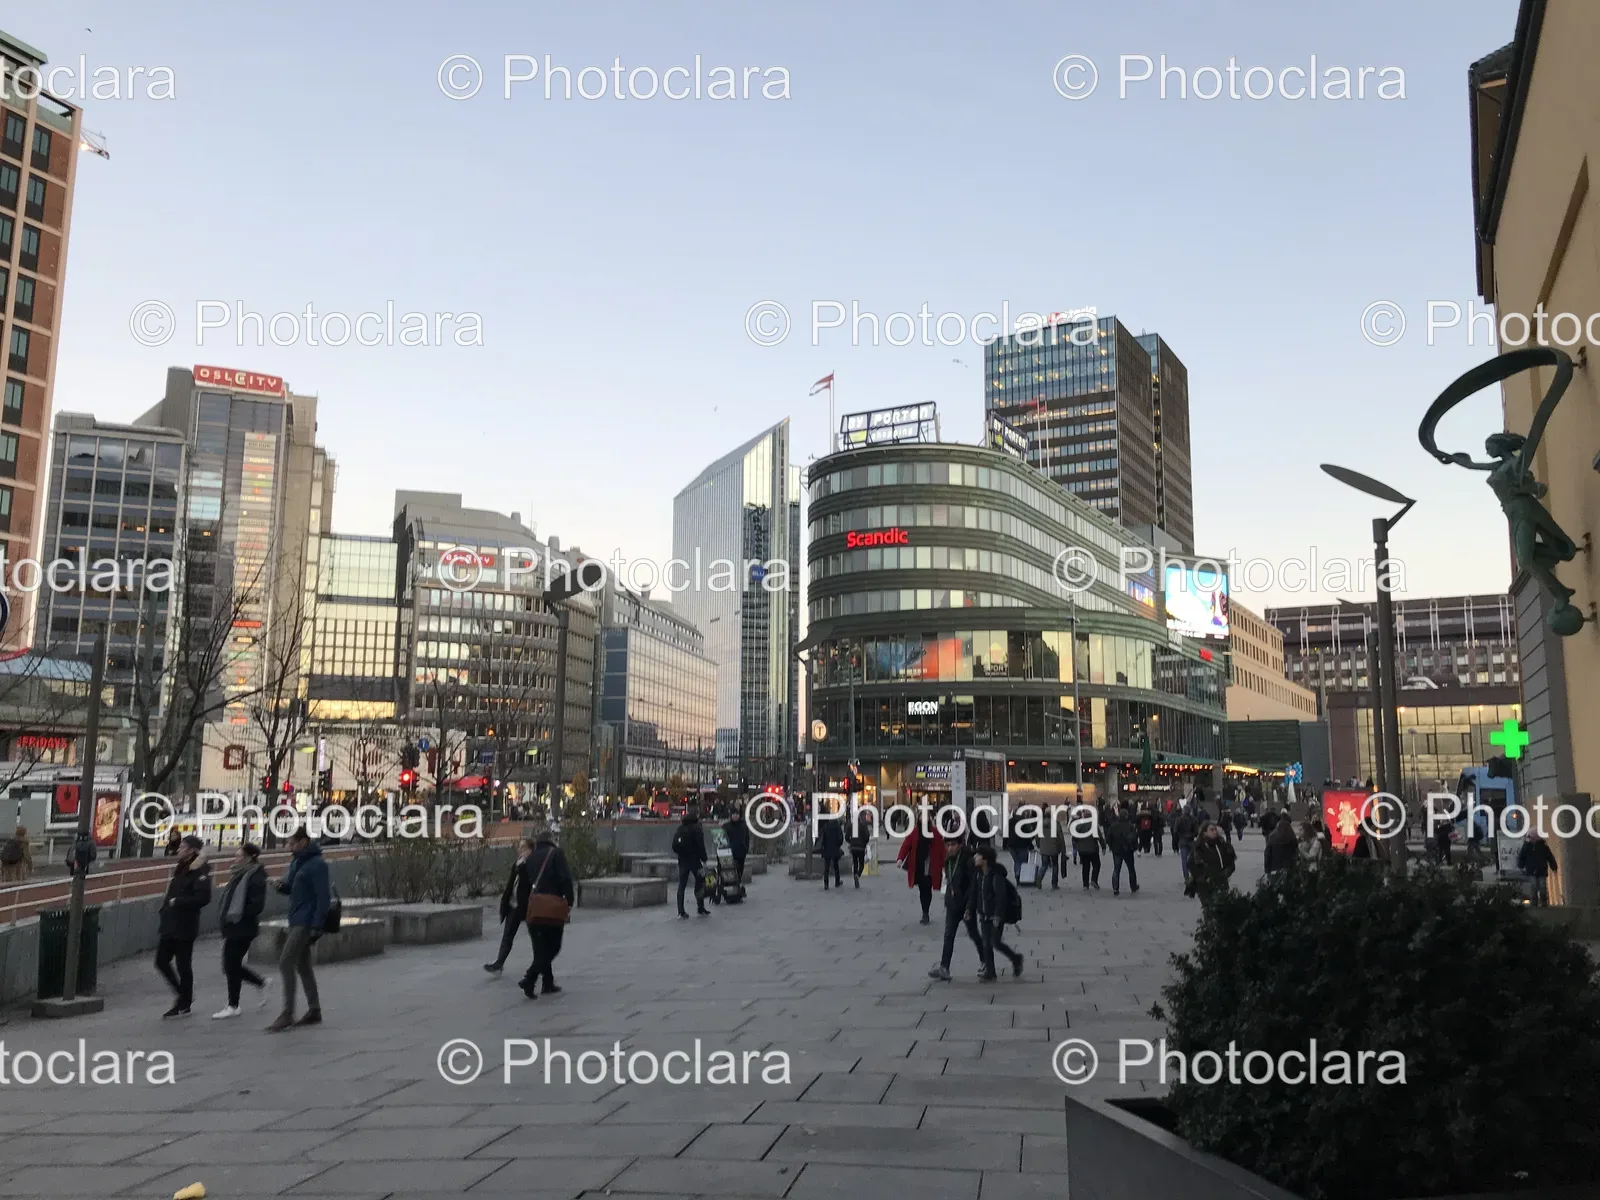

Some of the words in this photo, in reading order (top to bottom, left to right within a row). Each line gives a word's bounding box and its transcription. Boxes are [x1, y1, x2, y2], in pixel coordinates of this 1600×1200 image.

[848, 416, 864, 430] BY
[846, 527, 909, 548] Scandic
[908, 701, 938, 711] EGON
